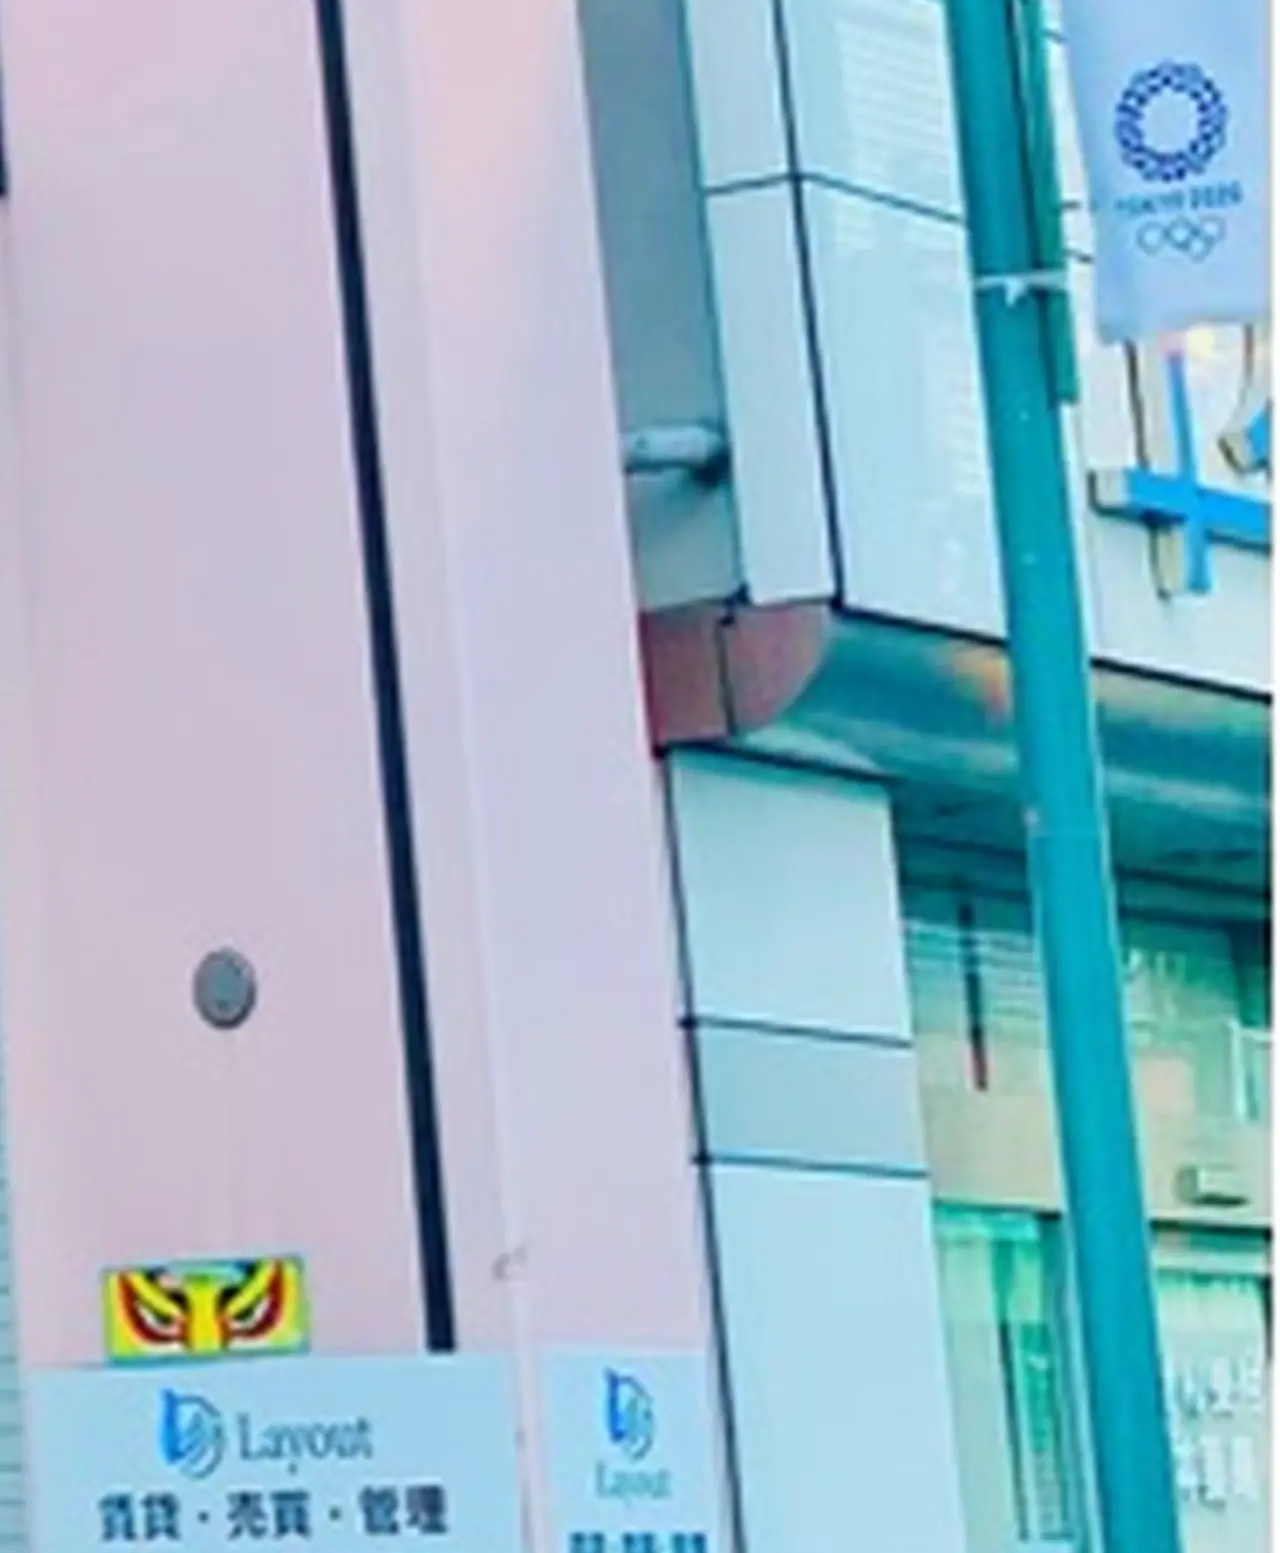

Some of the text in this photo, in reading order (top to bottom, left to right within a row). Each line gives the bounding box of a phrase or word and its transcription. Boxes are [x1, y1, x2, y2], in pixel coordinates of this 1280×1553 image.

[237, 1412, 373, 1474] Layout
[97, 1484, 448, 1542] 賃貸・売買・管理
